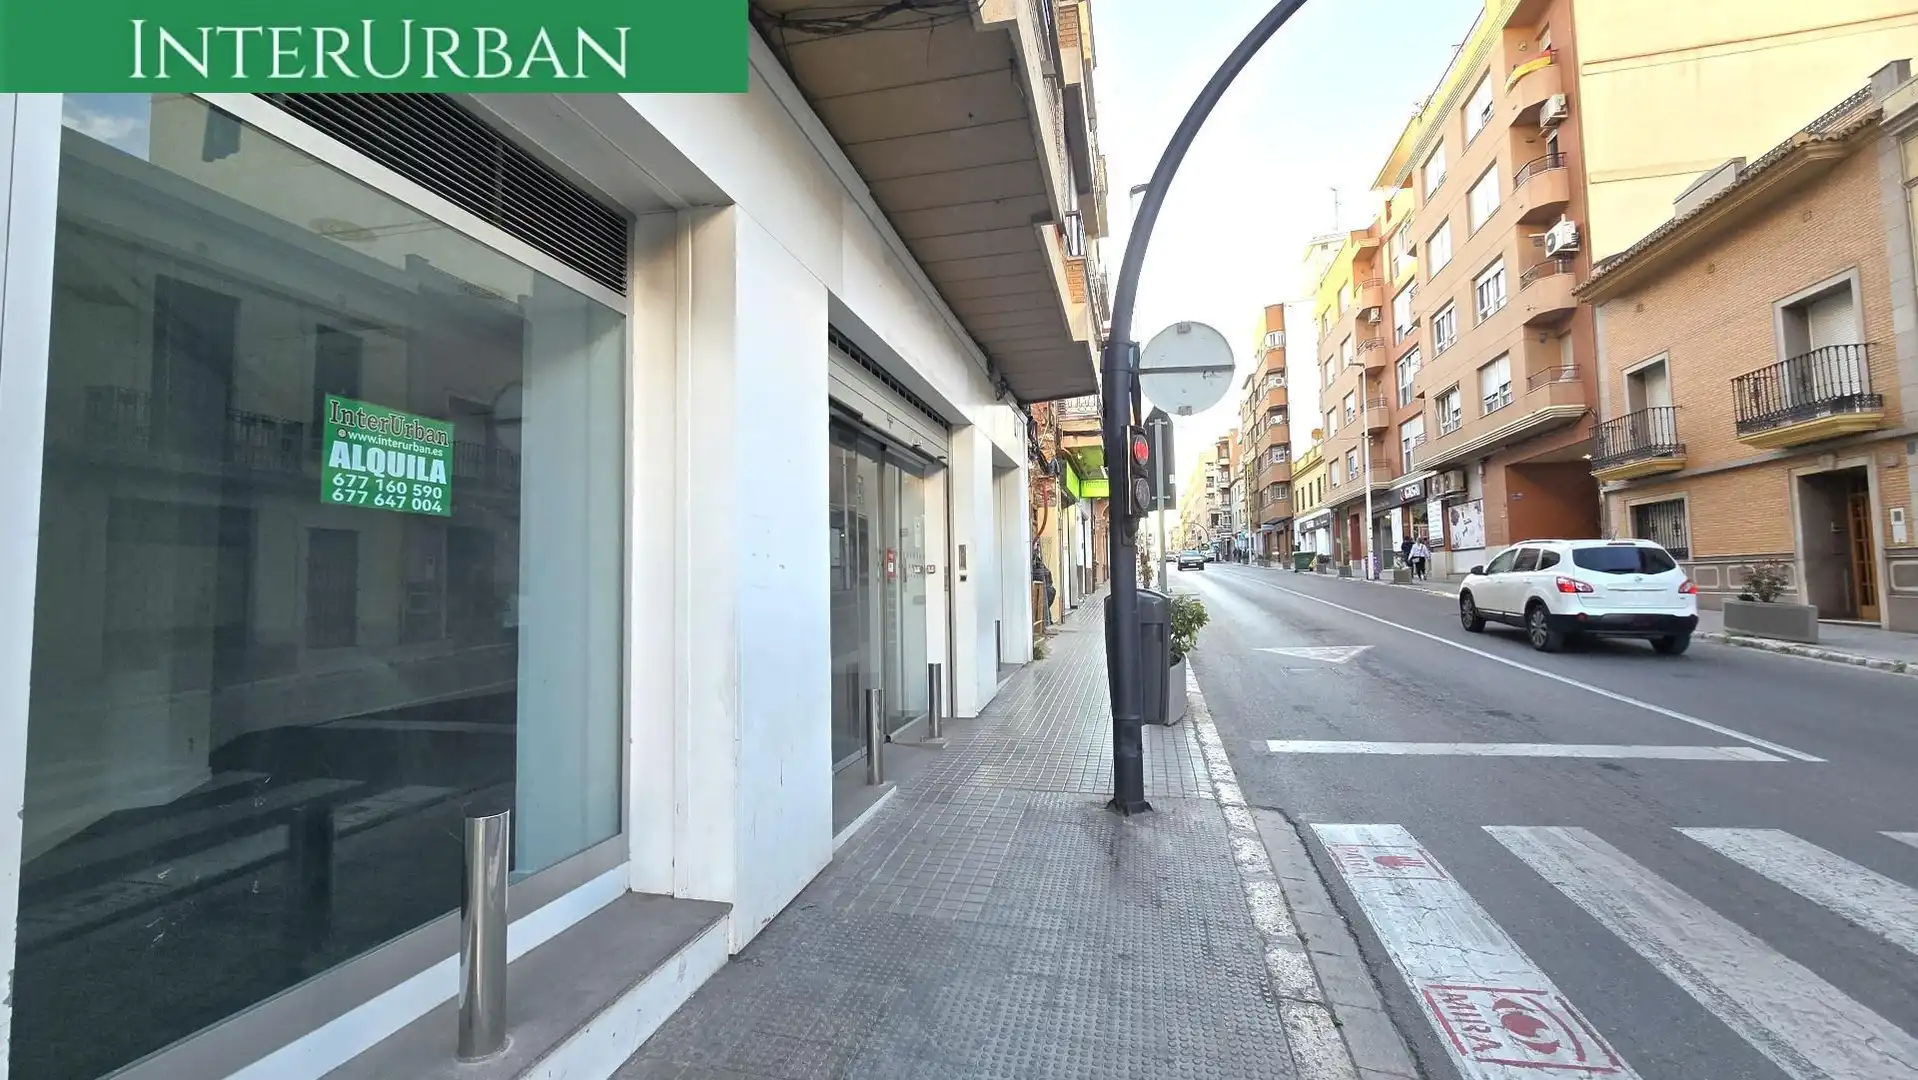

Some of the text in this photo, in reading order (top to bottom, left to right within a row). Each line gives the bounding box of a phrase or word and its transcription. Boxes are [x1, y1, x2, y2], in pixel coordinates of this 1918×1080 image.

[329, 399, 450, 447] InterUrban
[348, 431, 444, 457] www.interurban.es
[328, 440, 447, 485] ALQUILA
[332, 473, 442, 499] 677 160 590
[332, 488, 442, 512] 677 647 004
[1438, 992, 1503, 1052] MIRA
